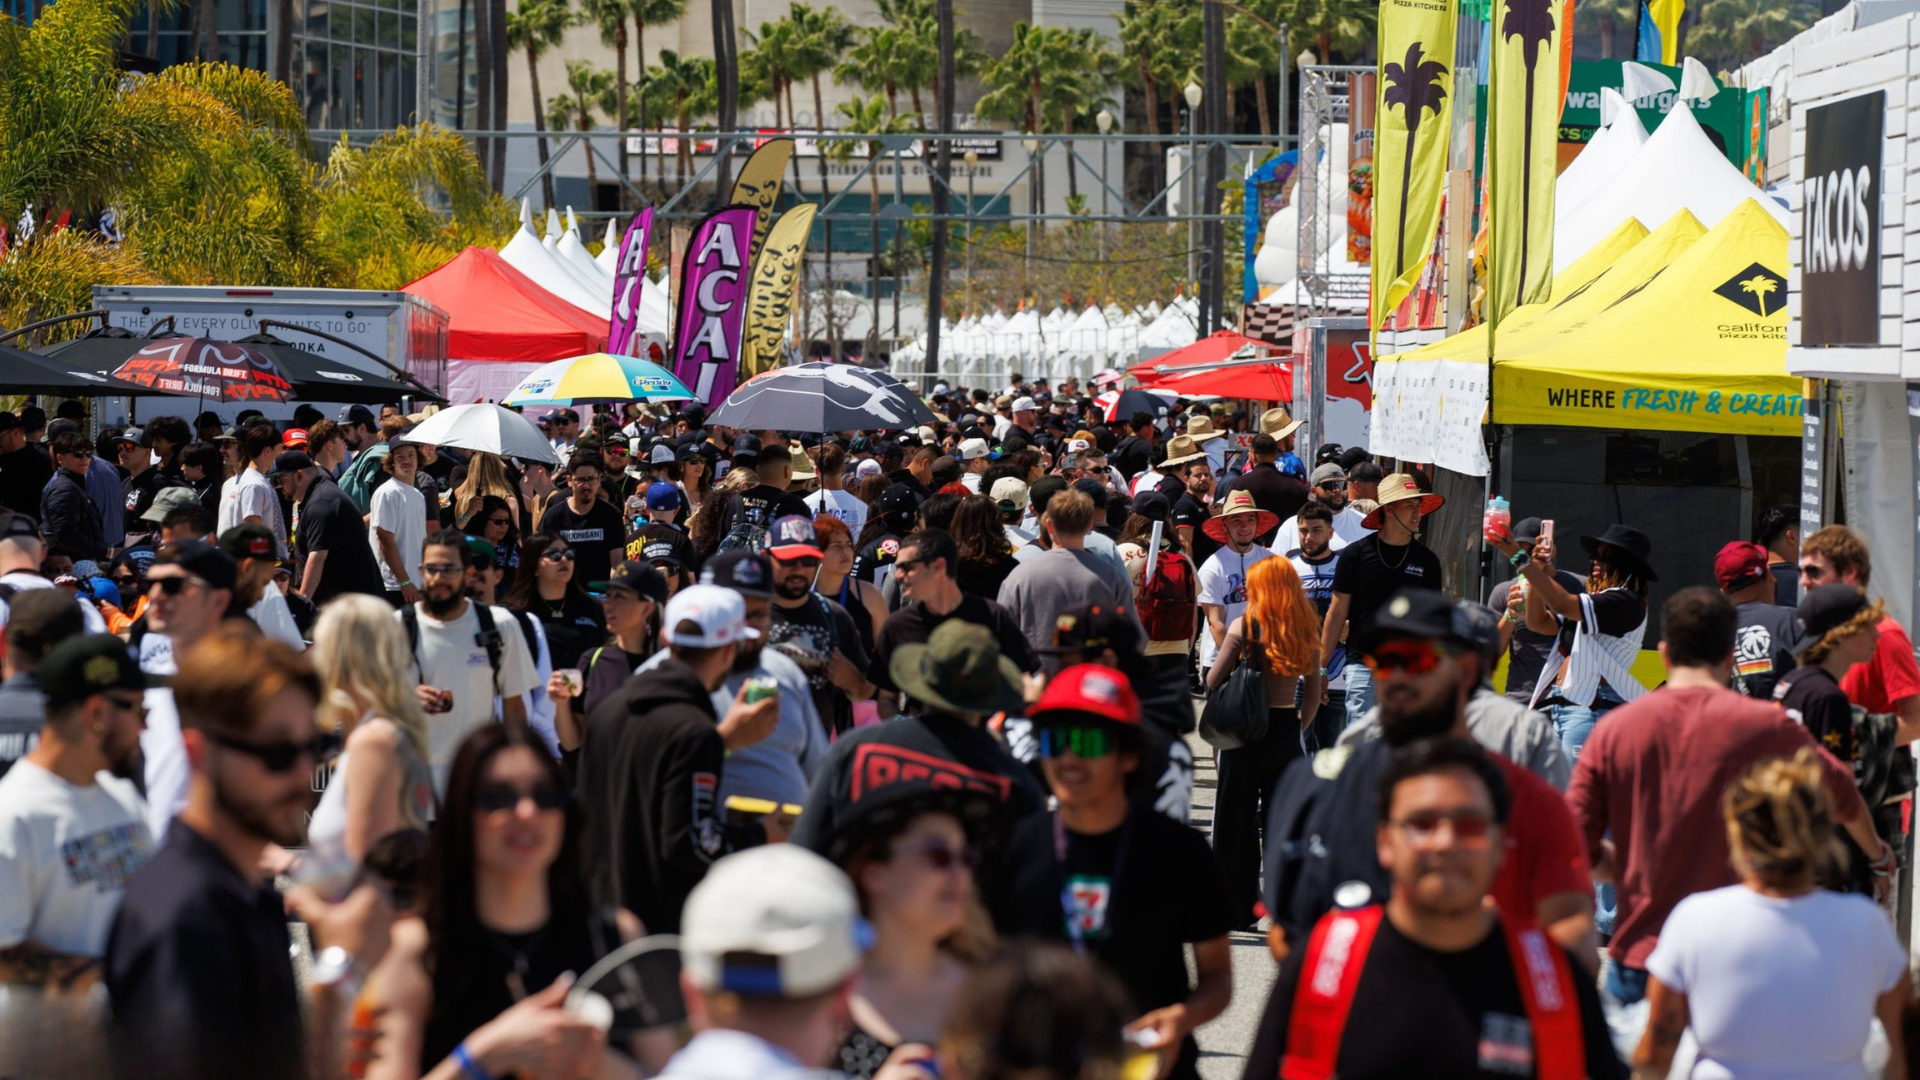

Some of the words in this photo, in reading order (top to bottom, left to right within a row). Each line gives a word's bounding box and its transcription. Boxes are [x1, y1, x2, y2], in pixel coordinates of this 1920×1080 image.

[1413, 3, 1447, 12] KITCHEN
[1804, 164, 1871, 275] TACOS
[685, 222, 742, 405] ACAI
[121, 316, 147, 328] THE
[183, 317, 227, 329] EVERY
[230, 318, 261, 330] OLIV
[326, 321, 343, 333] TO
[1762, 332, 1788, 340] kitc
[290, 342, 326, 353] ODKA
[183, 363, 221, 376] FORMULA
[1547, 388, 1615, 409] WHERE
[1622, 387, 1700, 414] FRESH
[1704, 390, 1722, 415] &
[1729, 393, 1804, 418] CREATI
